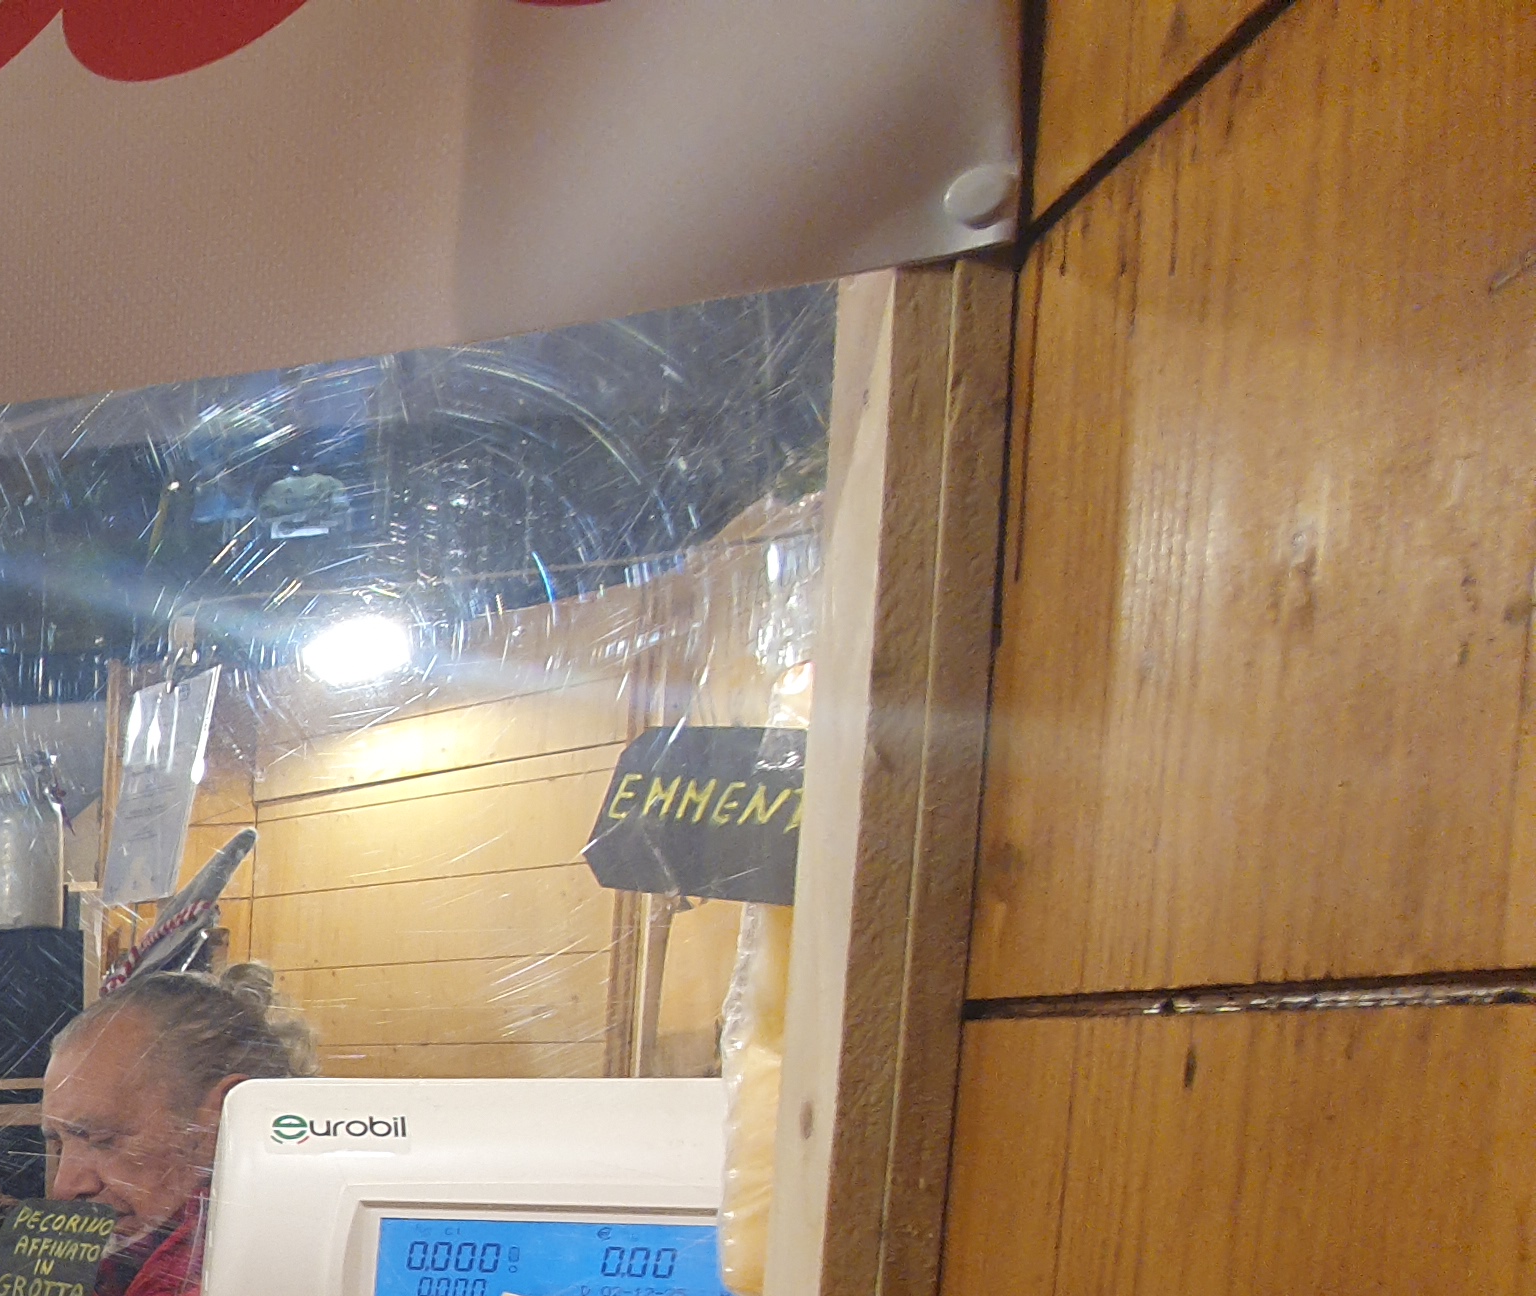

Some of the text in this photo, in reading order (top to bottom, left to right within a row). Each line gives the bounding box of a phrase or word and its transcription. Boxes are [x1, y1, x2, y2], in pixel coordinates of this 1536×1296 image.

[271, 1113, 407, 1144] eurobil
[13, 1206, 115, 1235] PECORINO
[14, 1237, 101, 1263] AFFINATO
[33, 1258, 54, 1276] IN
